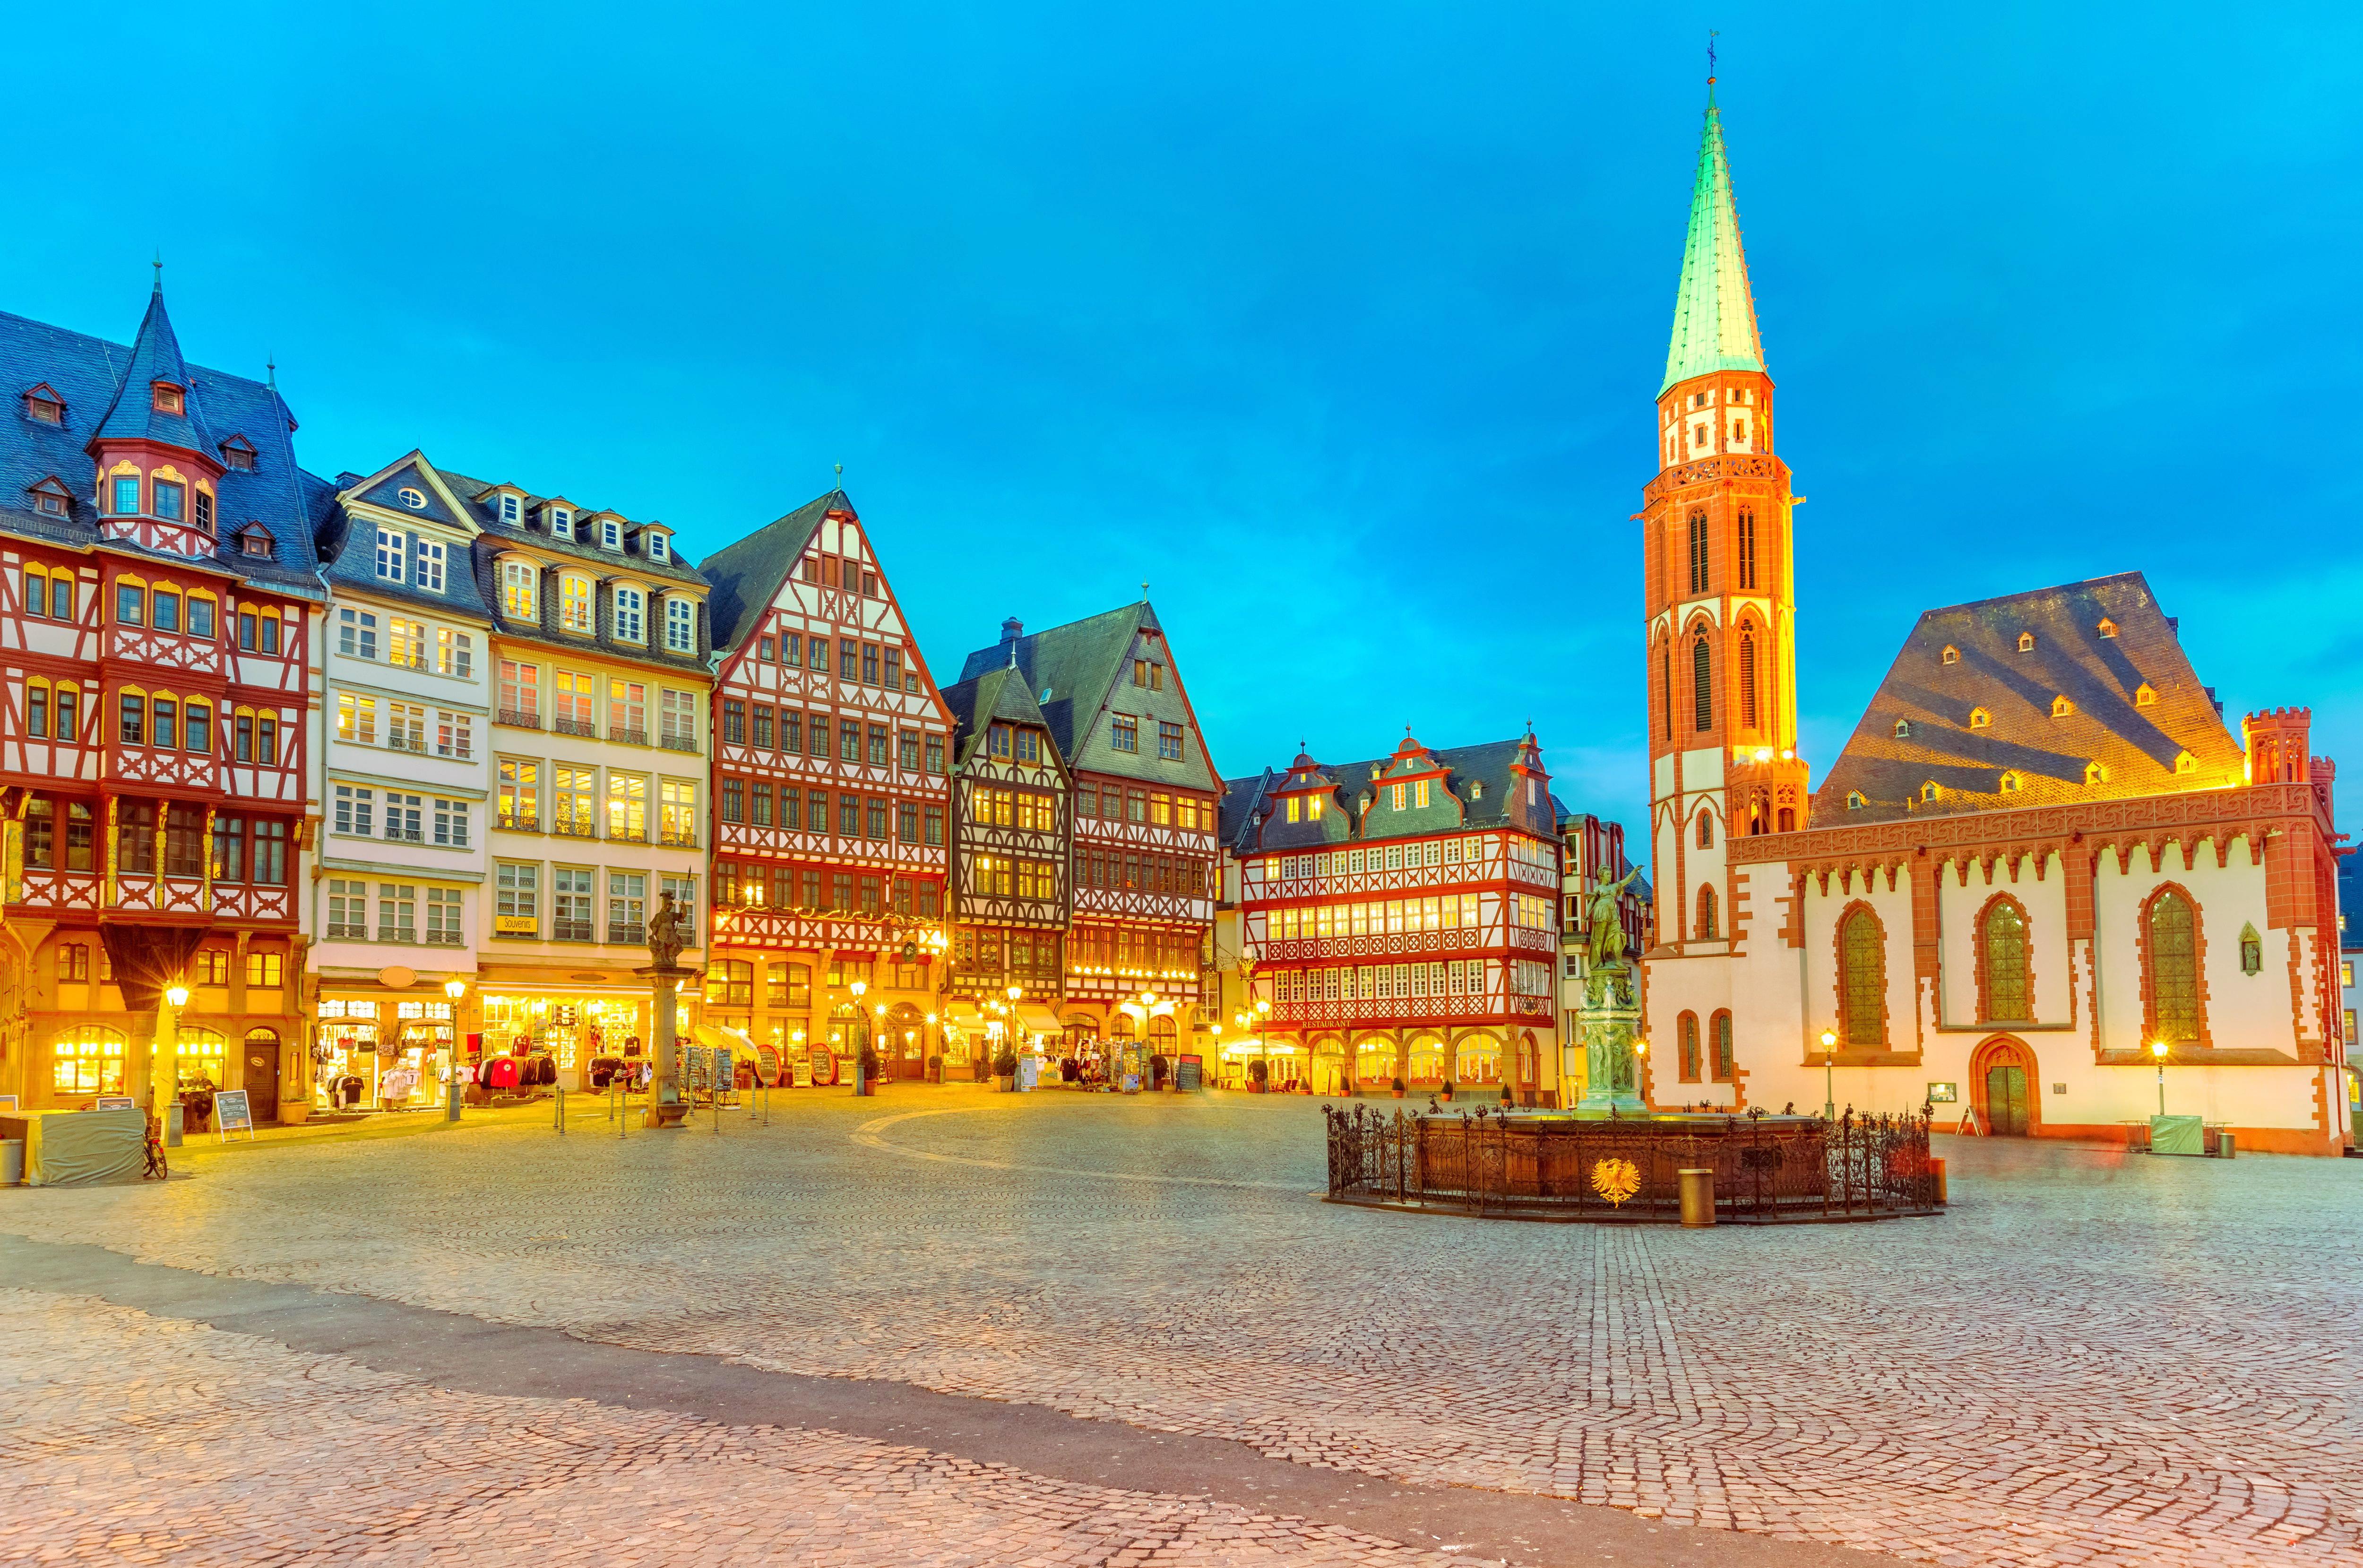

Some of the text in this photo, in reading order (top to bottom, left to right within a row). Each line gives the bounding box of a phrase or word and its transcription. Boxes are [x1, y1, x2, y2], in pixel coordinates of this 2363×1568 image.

[505, 918, 530, 929] Souvenirs
[1302, 1020, 1351, 1028] RESTAURANT
[410, 1075, 414, 1083] 7
